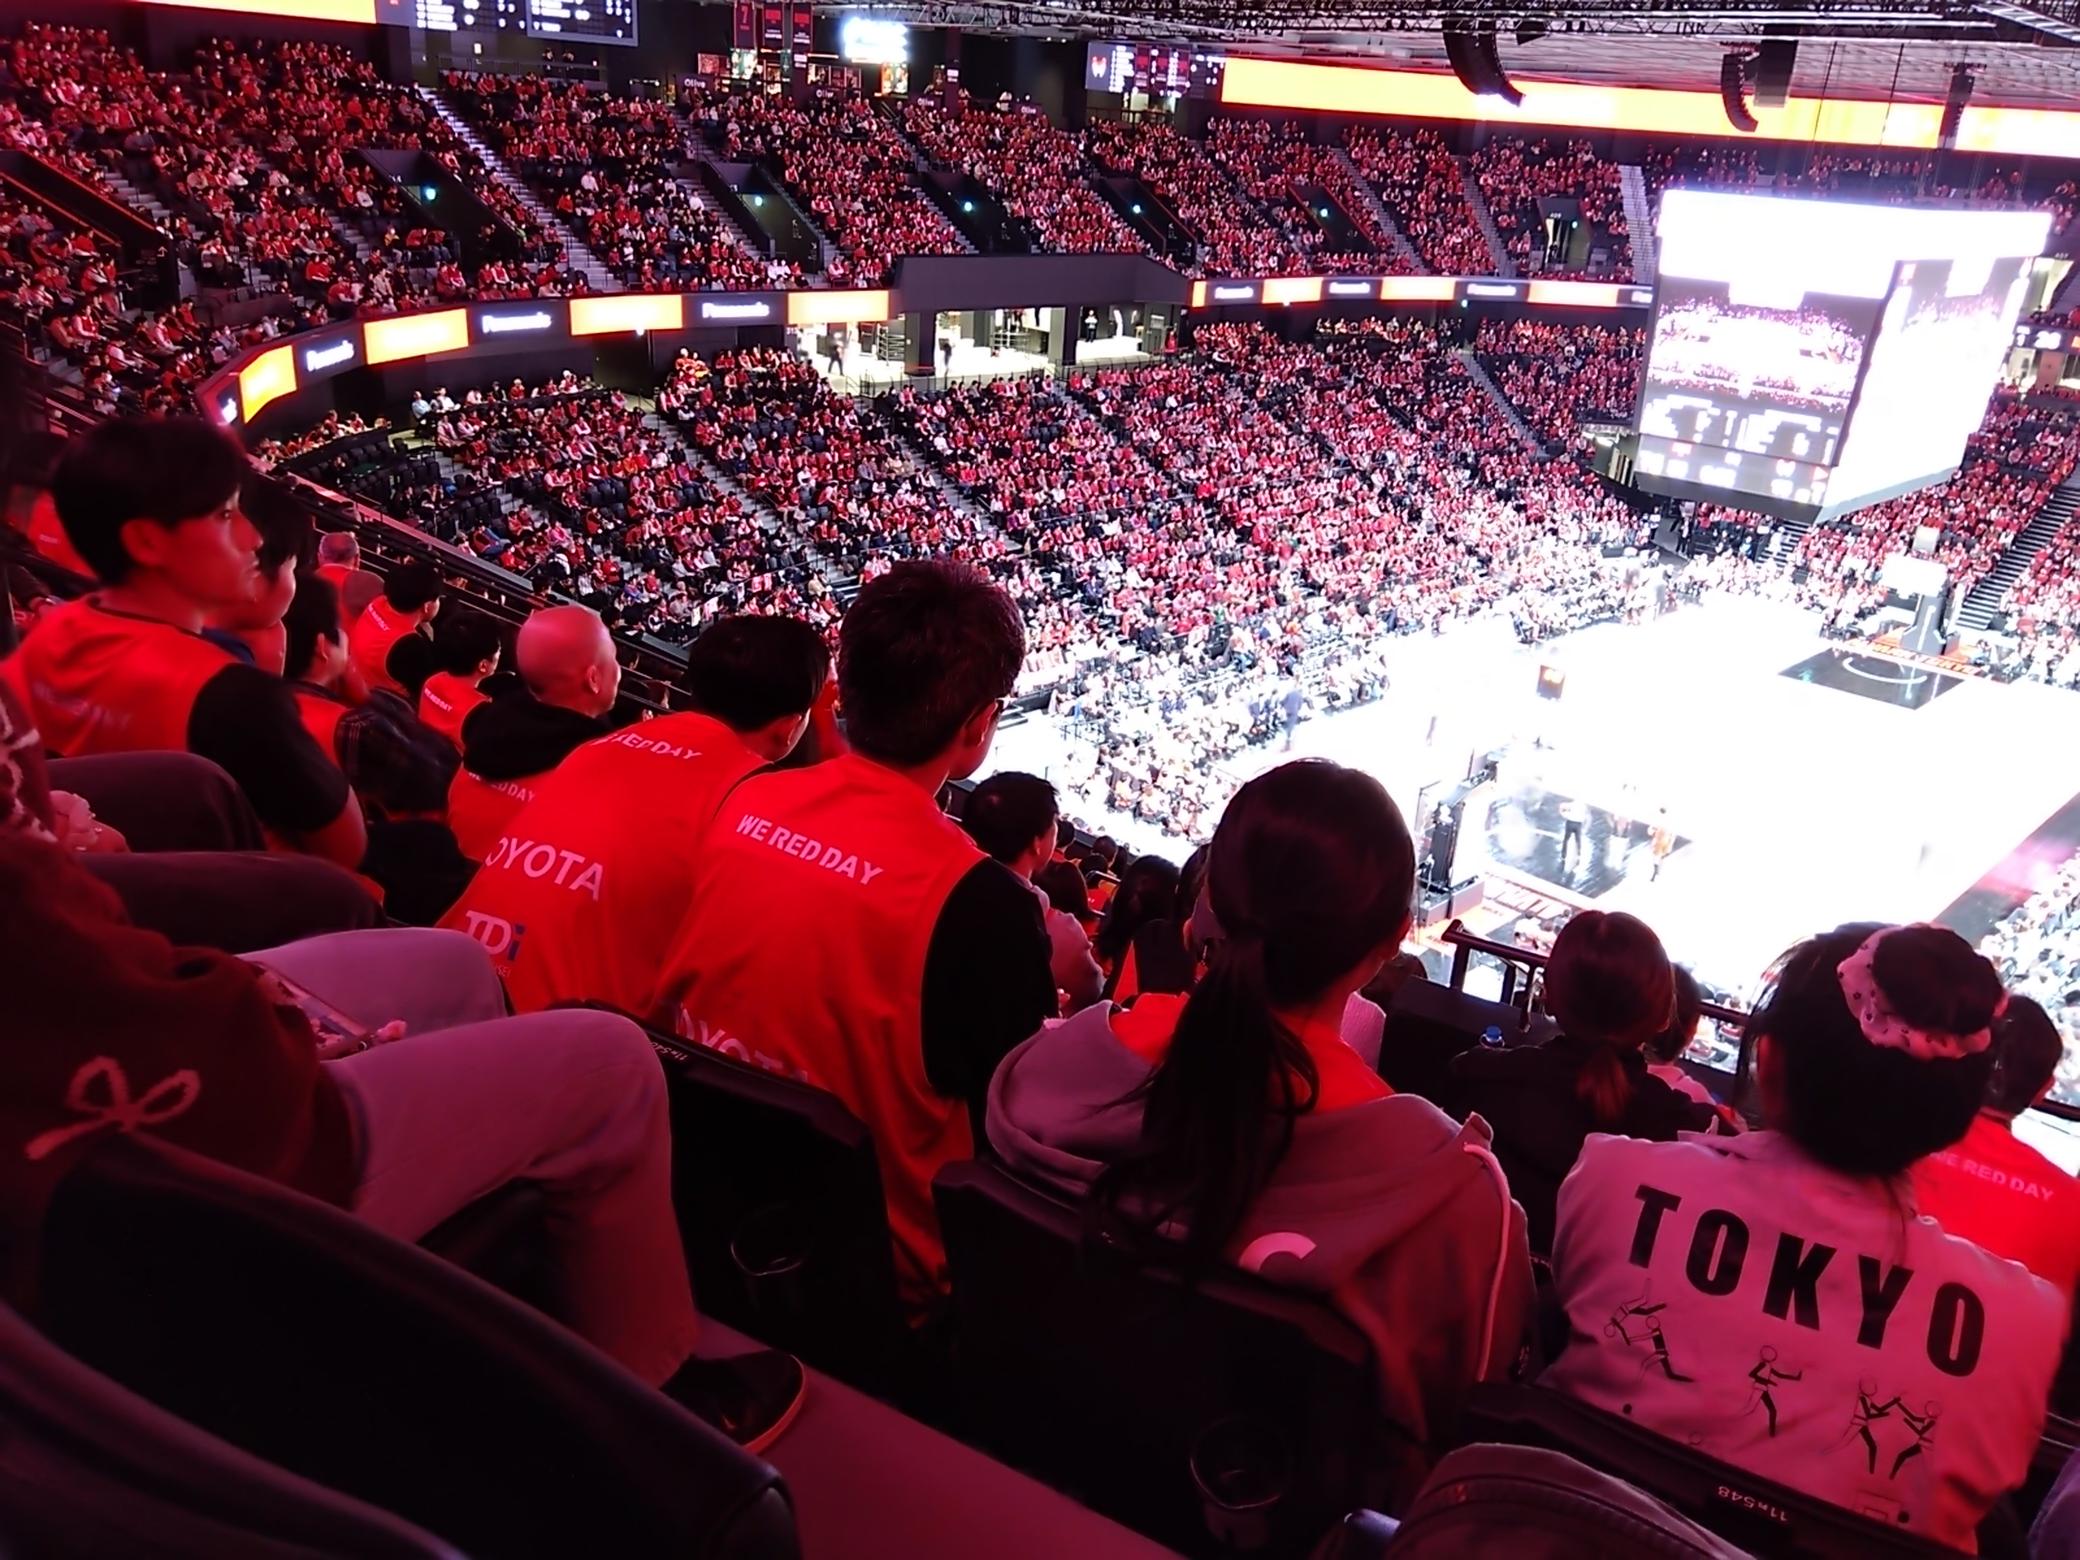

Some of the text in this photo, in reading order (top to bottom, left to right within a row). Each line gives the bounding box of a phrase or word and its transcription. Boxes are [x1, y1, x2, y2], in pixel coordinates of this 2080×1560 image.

[507, 782, 536, 802] DAY
[485, 836, 604, 902] OYOTA
[736, 814, 884, 885] WE RED DAY
[1963, 1158, 2007, 1185] RED
[2009, 1176, 2055, 1202] DAY
[1628, 1183, 1986, 1378] TOKYO
